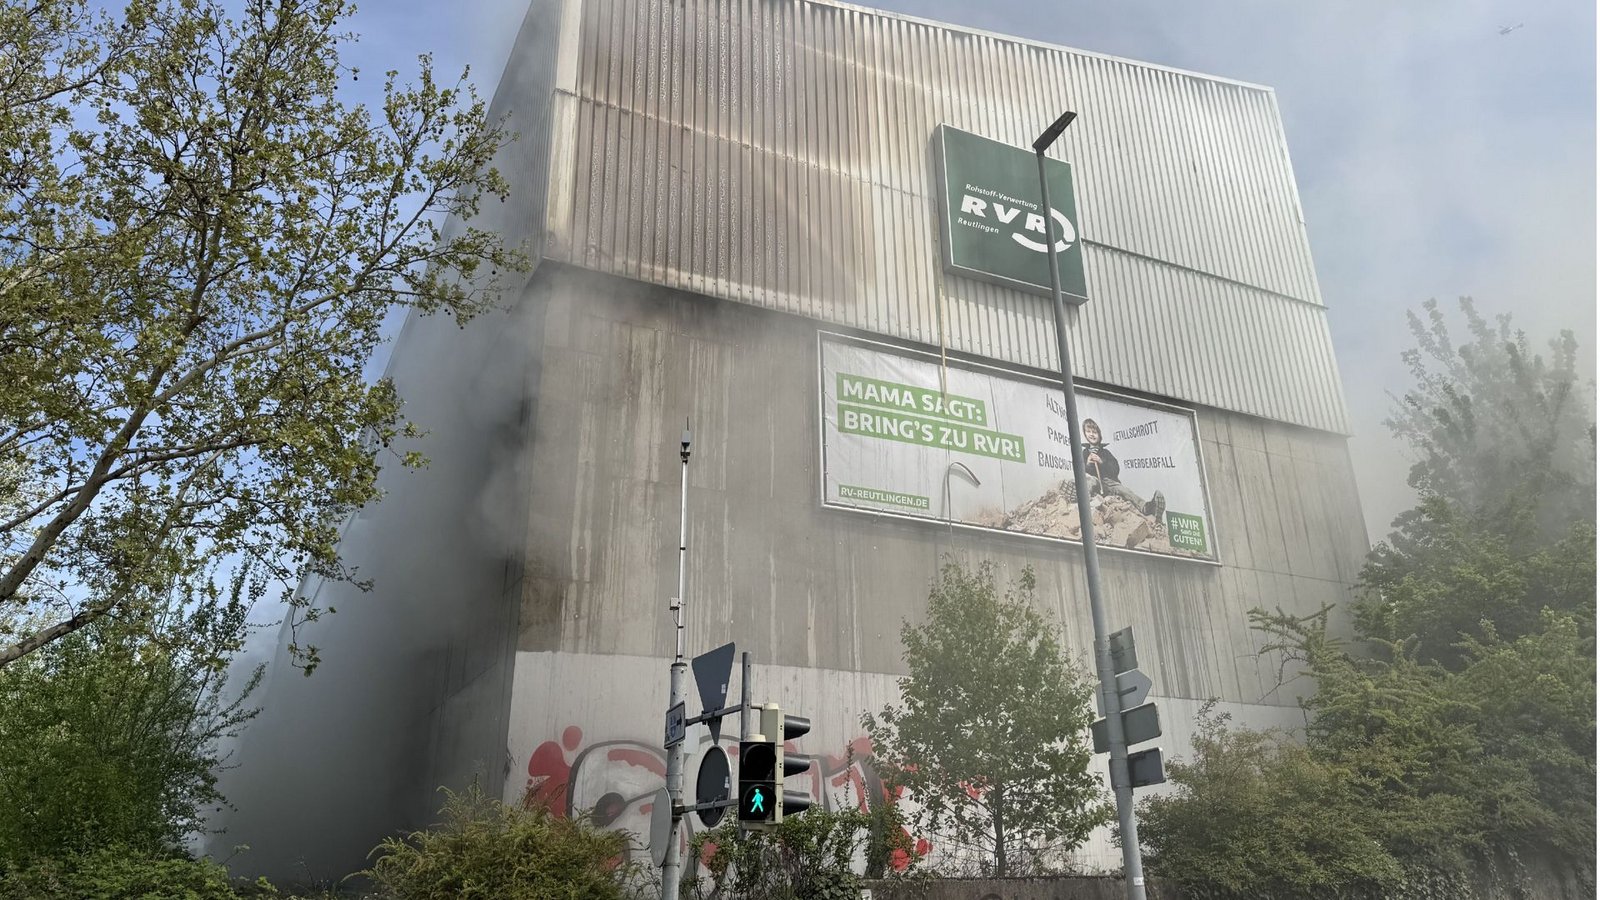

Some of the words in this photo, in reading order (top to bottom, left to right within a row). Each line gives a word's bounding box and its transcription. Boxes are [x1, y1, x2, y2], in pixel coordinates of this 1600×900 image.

[966, 183, 1038, 210] Rohstoff-Verwertung
[958, 217, 1000, 234] Reutlingen
[843, 379, 917, 409] MAMA
[921, 394, 983, 422] SAGT:
[844, 410, 935, 442] BRING’S
[939, 426, 968, 448] ZU
[973, 433, 1021, 458] RVR!
[1047, 426, 1072, 446] PAPIE
[840, 486, 928, 508] RV-REUTLINGEN.DE
[1171, 516, 1200, 531] #WIR
[1173, 534, 1203, 546] GUTEN!
